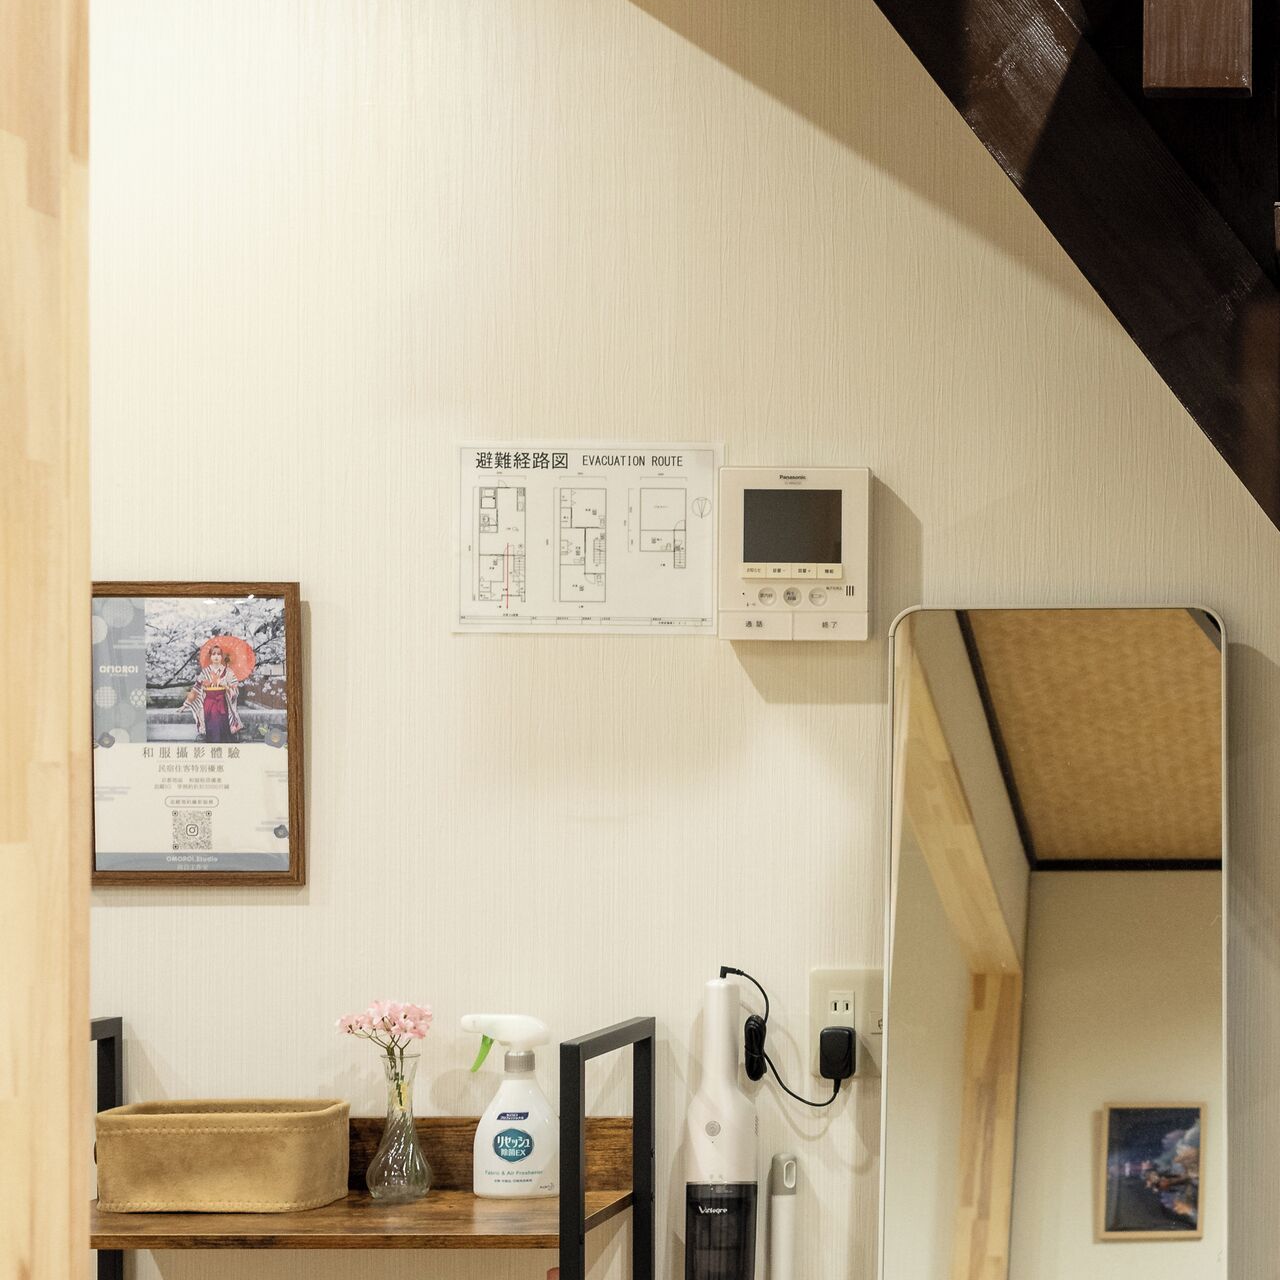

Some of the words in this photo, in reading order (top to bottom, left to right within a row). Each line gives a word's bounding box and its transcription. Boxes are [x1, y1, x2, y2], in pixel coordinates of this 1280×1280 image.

[475, 451, 569, 470] 避難経路図
[582, 455, 646, 467] EVACUATION
[651, 455, 684, 467] ROUTE
[821, 621, 838, 629] 終了
[497, 1135, 530, 1148] リセッシュ
